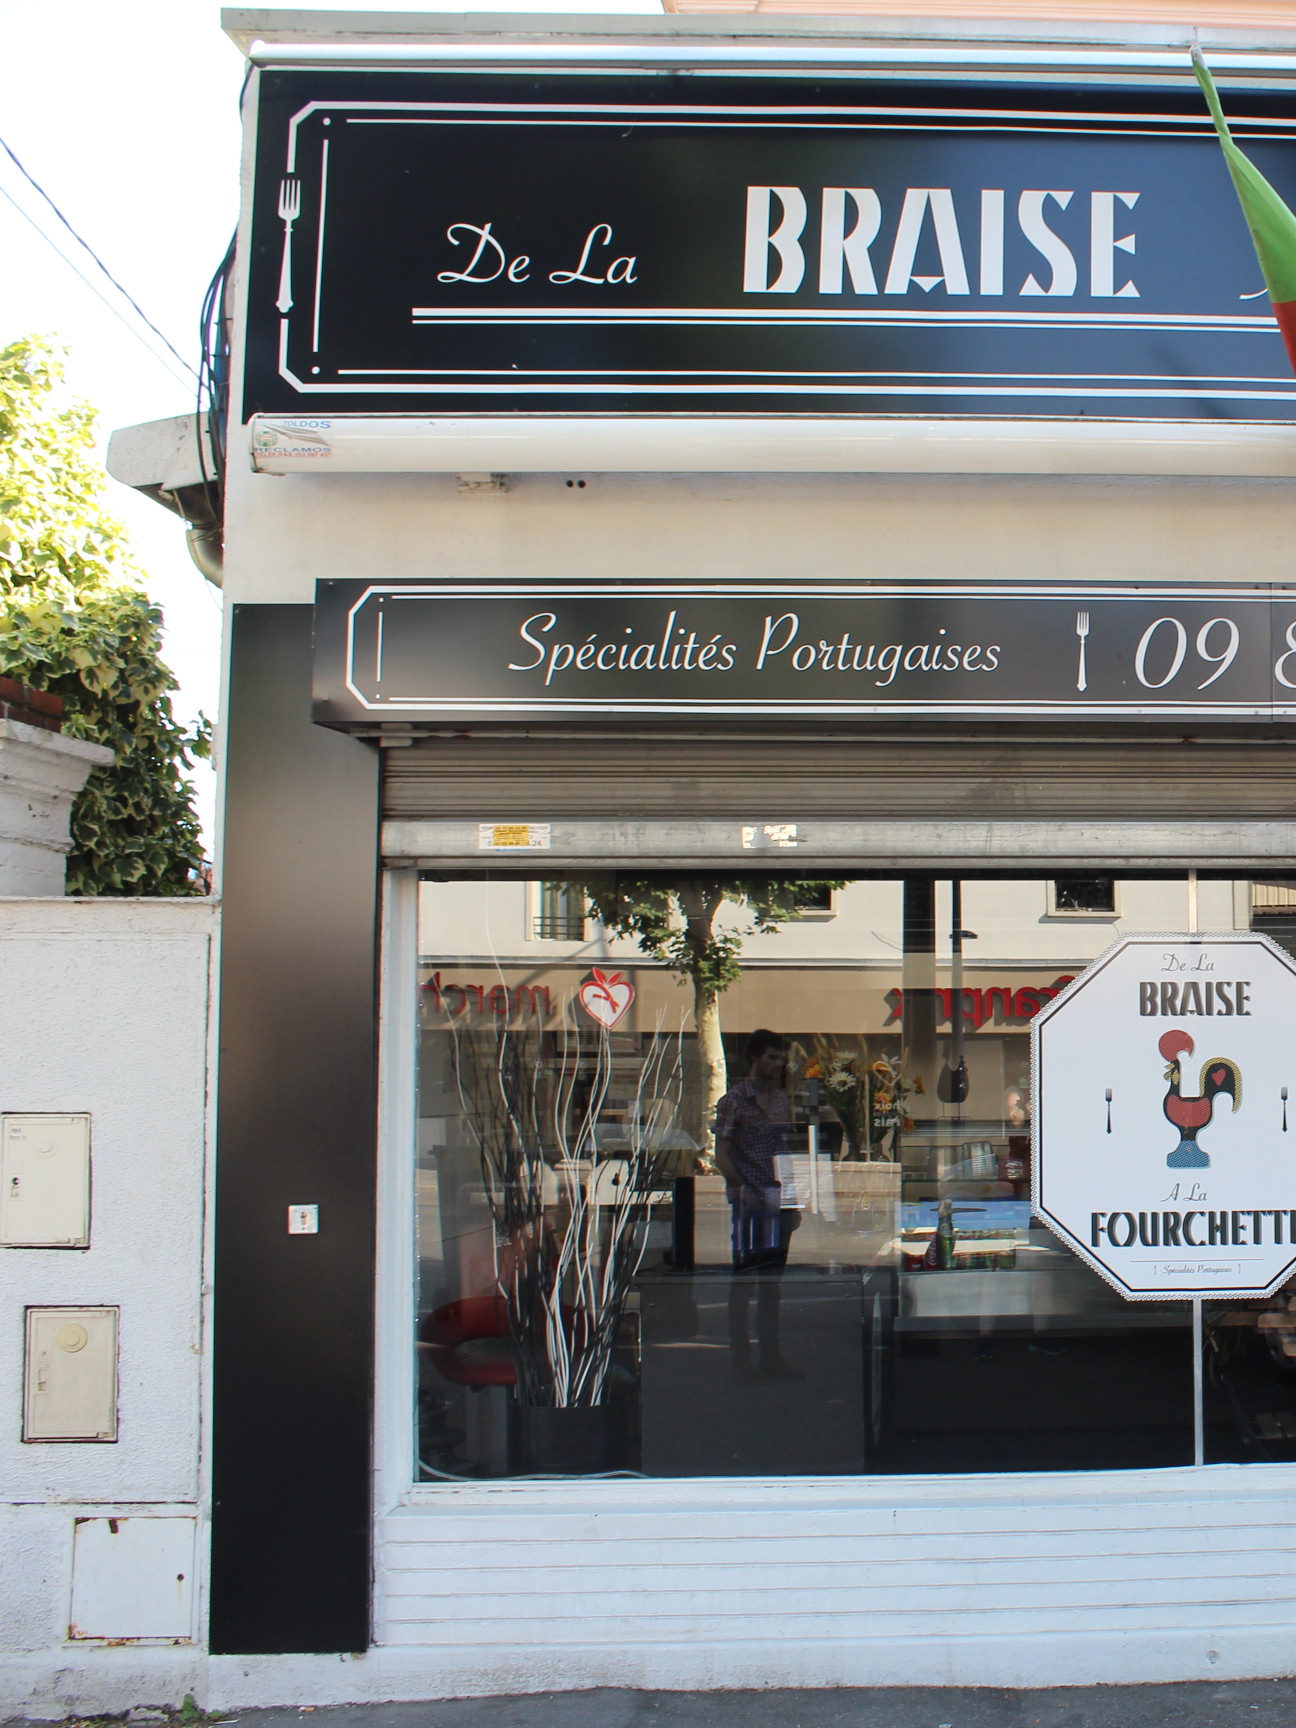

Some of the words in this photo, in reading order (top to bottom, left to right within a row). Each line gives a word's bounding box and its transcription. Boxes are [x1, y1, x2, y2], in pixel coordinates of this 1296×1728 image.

[437, 222, 530, 283] De
[549, 223, 638, 284] La
[743, 185, 1141, 298] BRAISE
[283, 420, 332, 429] TOLDOS
[508, 610, 737, 686] Spécialités
[756, 612, 1001, 688] Portugaises
[1134, 617, 1240, 690] 09
[1159, 952, 1188, 972] De
[1190, 952, 1215, 972] La
[1139, 980, 1253, 1017] BRAISE
[1160, 1183, 1181, 1203] A
[1182, 1182, 1208, 1202] La
